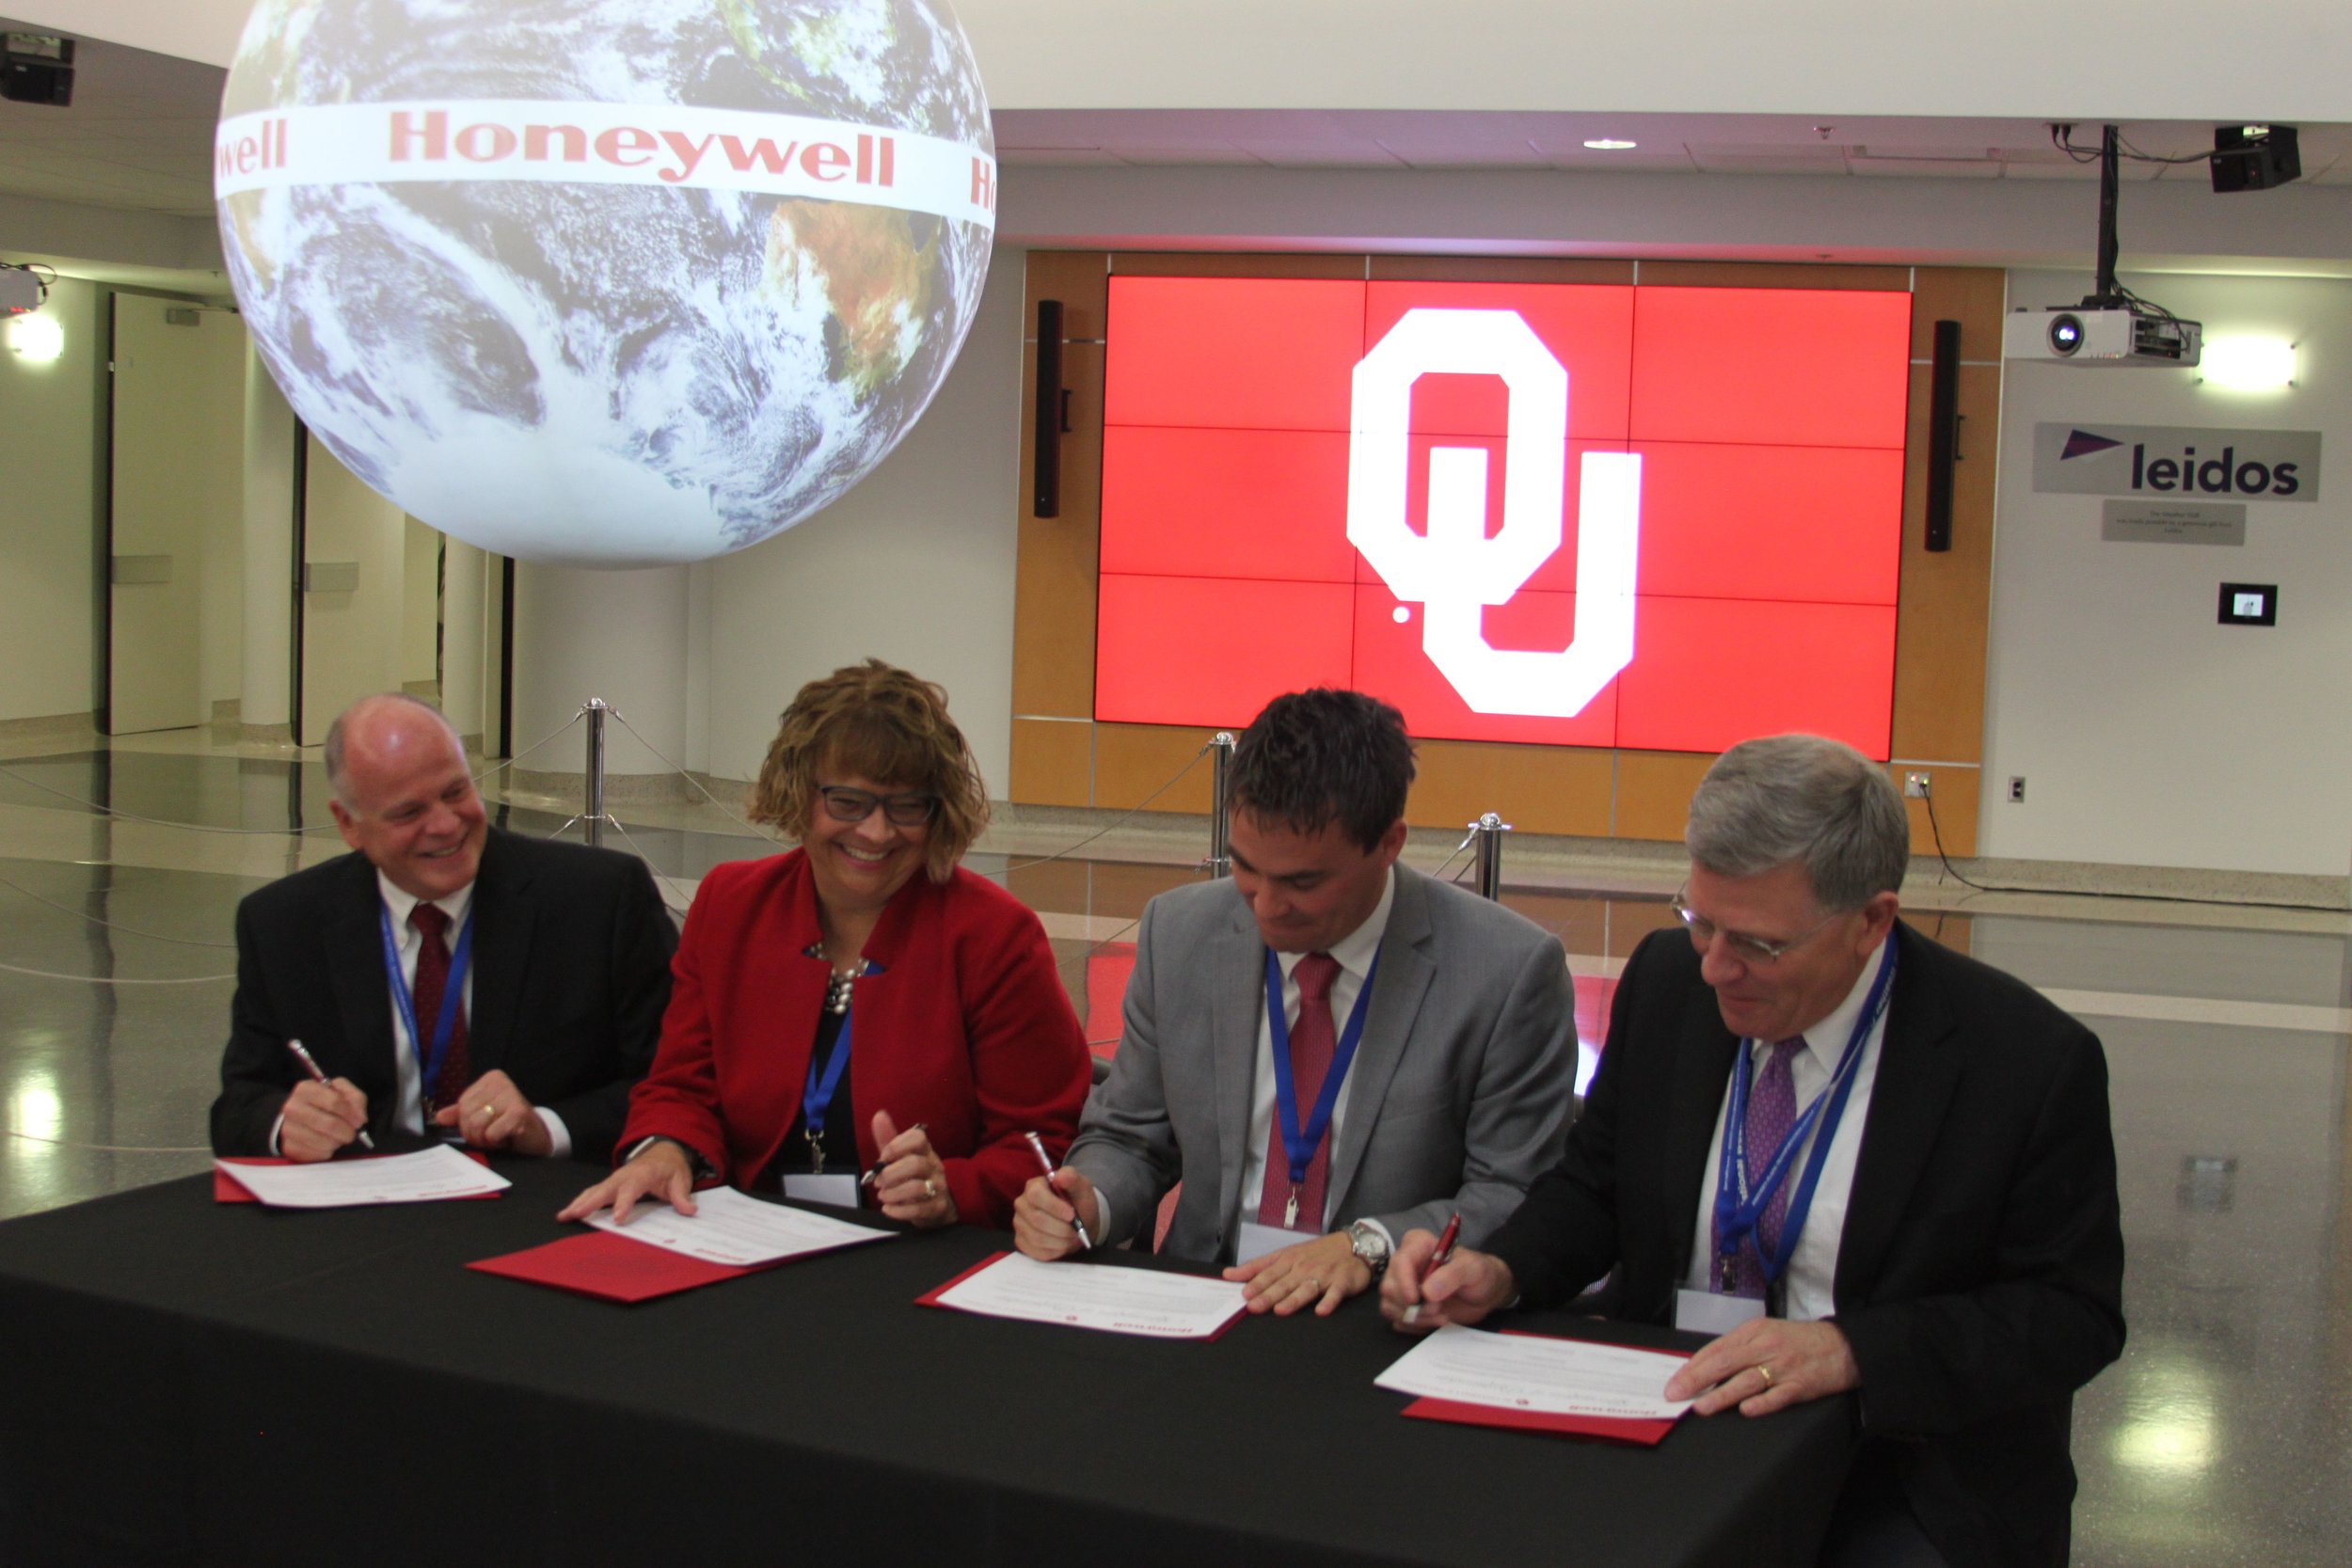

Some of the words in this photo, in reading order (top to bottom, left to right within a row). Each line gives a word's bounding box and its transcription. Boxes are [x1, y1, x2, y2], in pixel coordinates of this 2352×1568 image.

[389, 109, 895, 189] Honeywell
[2131, 443, 2299, 496] leidos
[1346, 308, 1642, 718] OU
